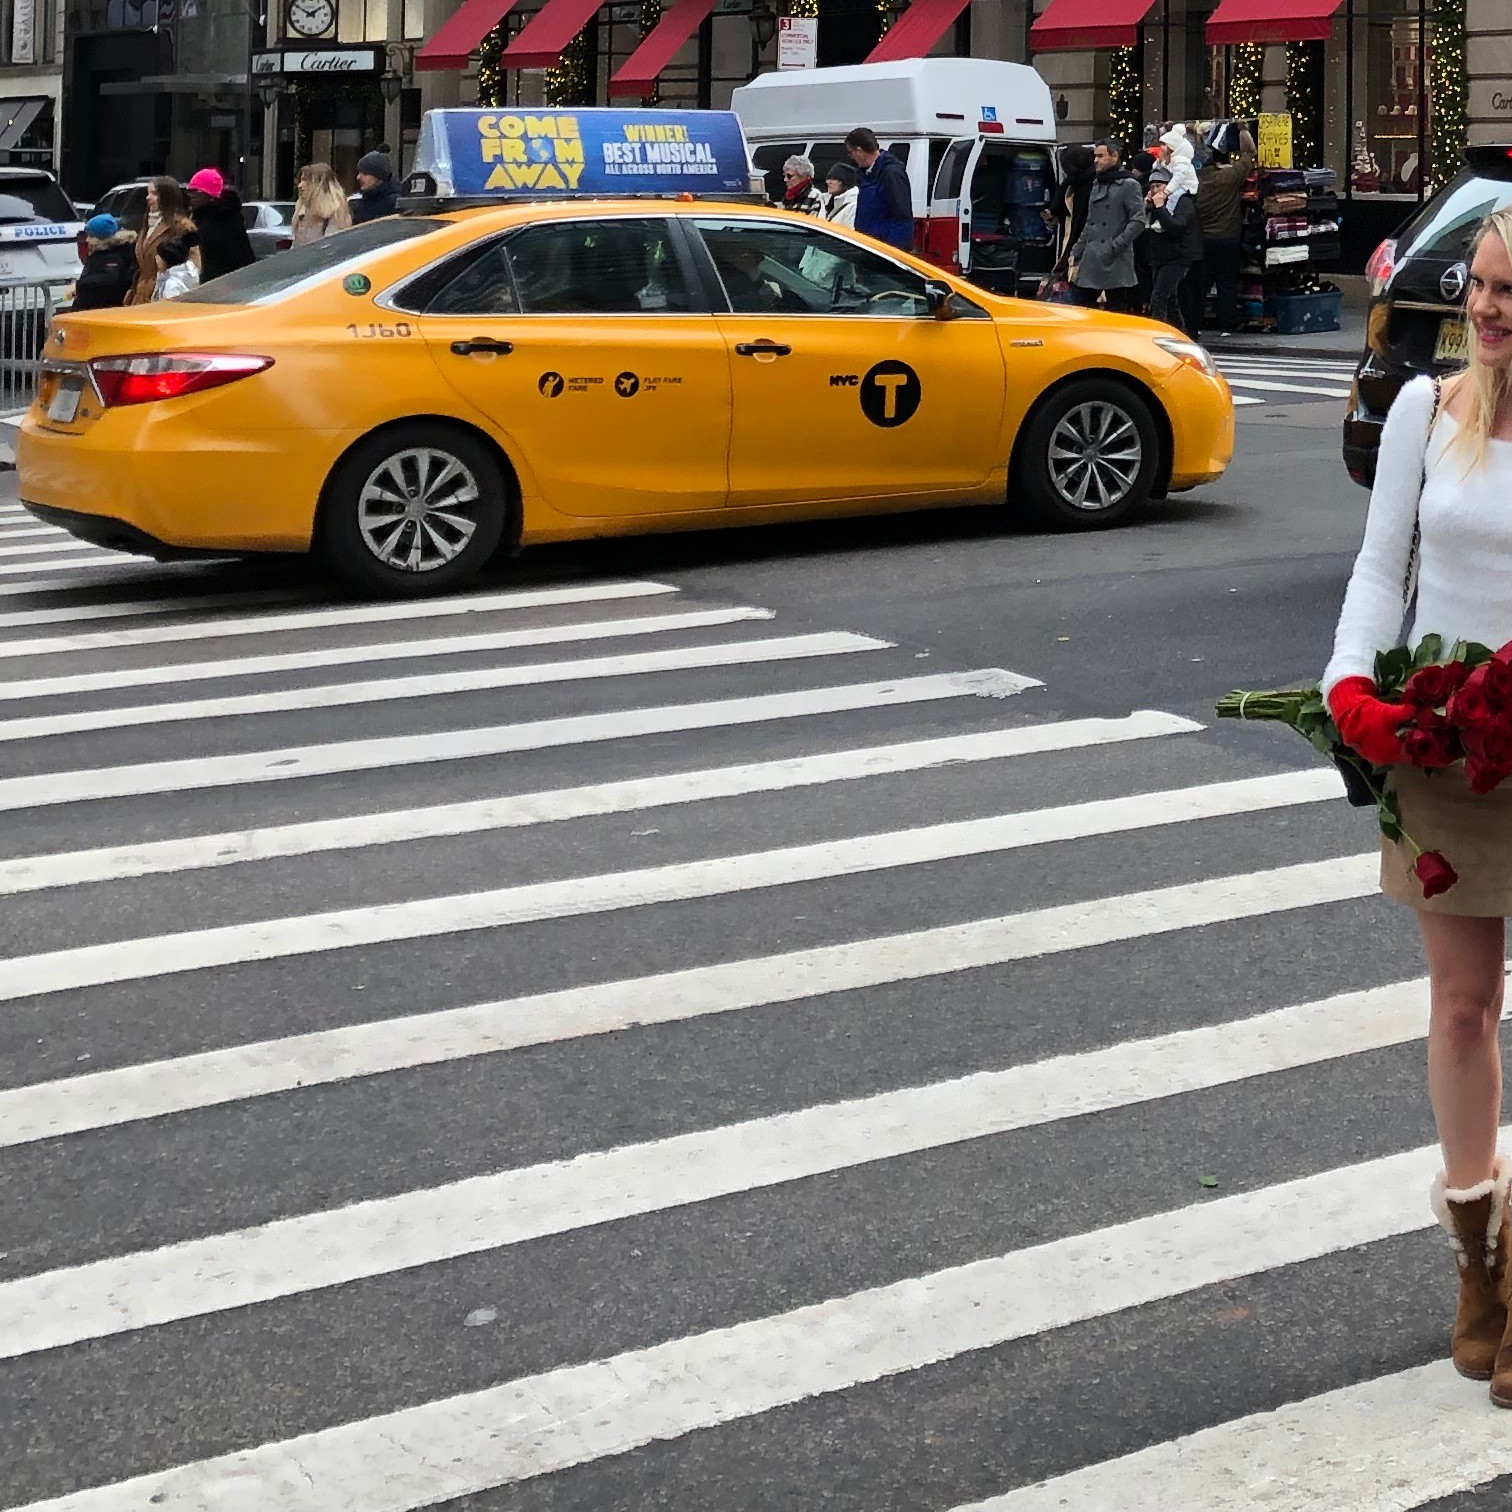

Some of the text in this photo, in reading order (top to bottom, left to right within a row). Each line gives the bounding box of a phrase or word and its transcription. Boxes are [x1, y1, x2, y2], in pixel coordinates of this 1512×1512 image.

[300, 51, 357, 70] Cartier
[477, 115, 580, 139] COME
[623, 124, 690, 142] WINNER!
[602, 142, 717, 164] BEST MUSICAL
[484, 163, 586, 190] AWAY
[604, 163, 621, 175] ALL
[14, 225, 67, 238] POLICE
[829, 373, 907, 419] NYC T
